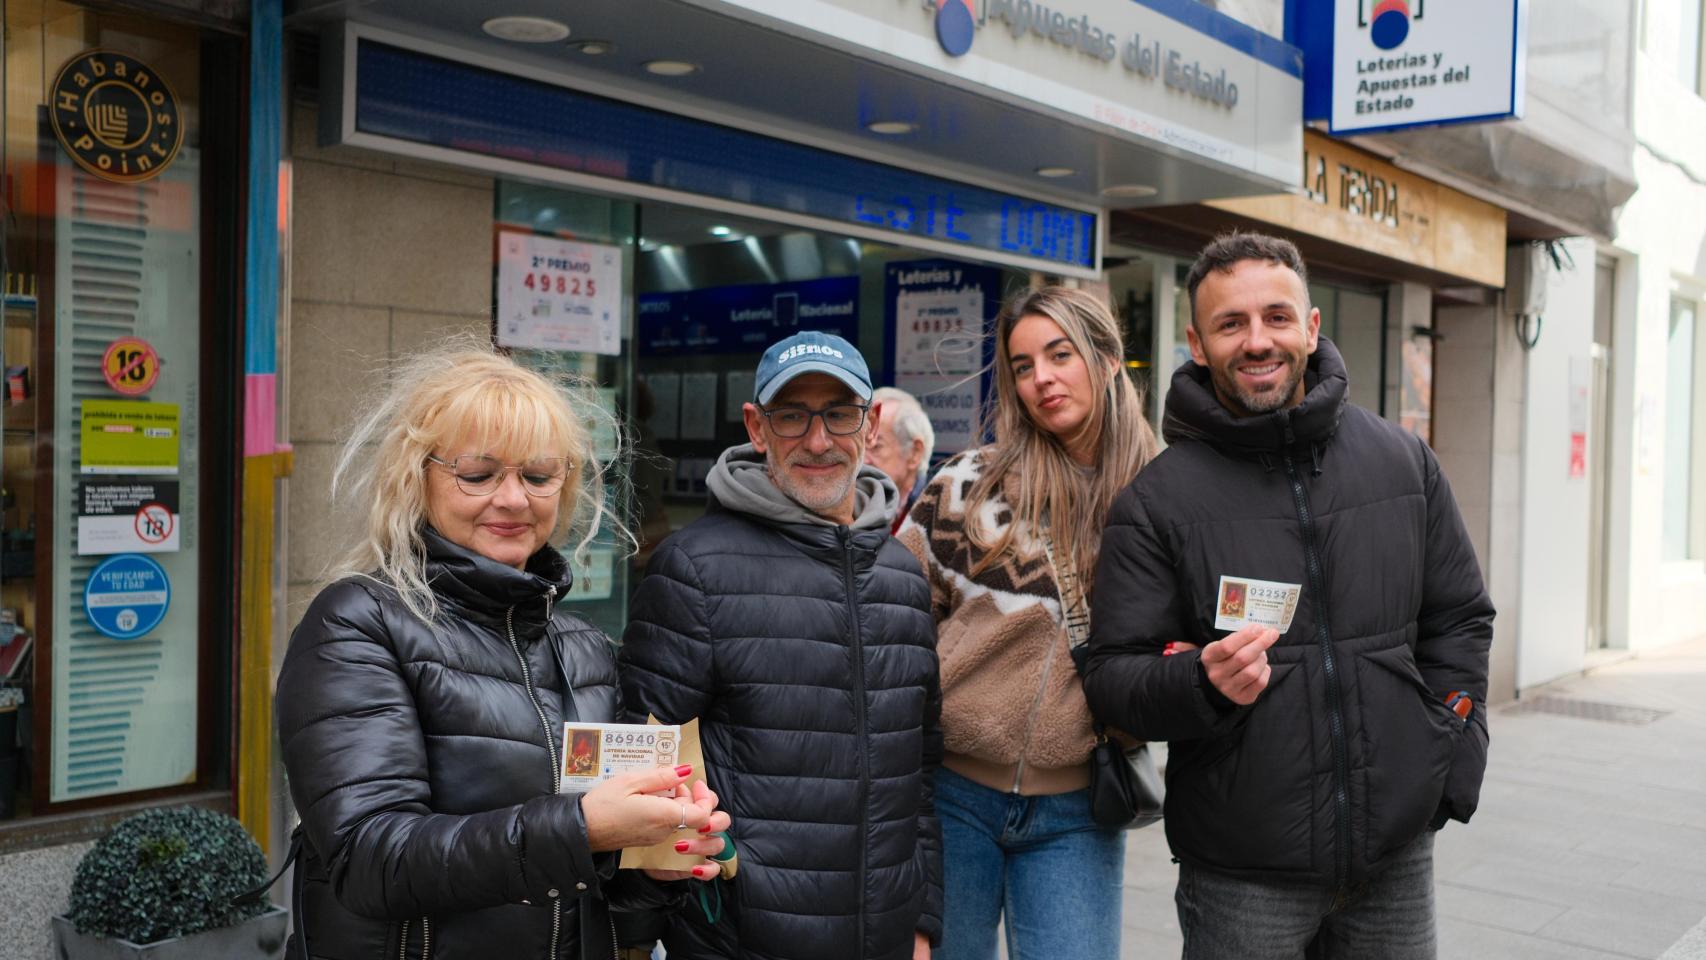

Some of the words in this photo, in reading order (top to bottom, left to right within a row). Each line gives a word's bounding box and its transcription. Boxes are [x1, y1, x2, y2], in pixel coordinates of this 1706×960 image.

[1121, 33, 1160, 80] del
[1163, 50, 1239, 109] Estado
[1356, 52, 1427, 74] Loterías
[1433, 52, 1443, 68] y
[1356, 72, 1437, 96] Apuestas
[1443, 65, 1471, 84] del
[58, 57, 171, 126] Habanos
[1355, 95, 1415, 116] Estado
[74, 134, 166, 174] Point
[547, 258, 591, 274] PREMIO
[524, 272, 597, 298] 49825
[898, 269, 951, 286] Loterías
[954, 270, 963, 285] y
[801, 300, 854, 317] Nacional
[778, 343, 843, 364] sifnos
[116, 350, 146, 381] 18
[145, 518, 164, 537] 18
[101, 570, 156, 582] VERIFICAMOS
[112, 581, 122, 590] TU
[124, 580, 145, 590] EDAD
[1250, 587, 1287, 599] 02252
[605, 734, 655, 745] 86940
